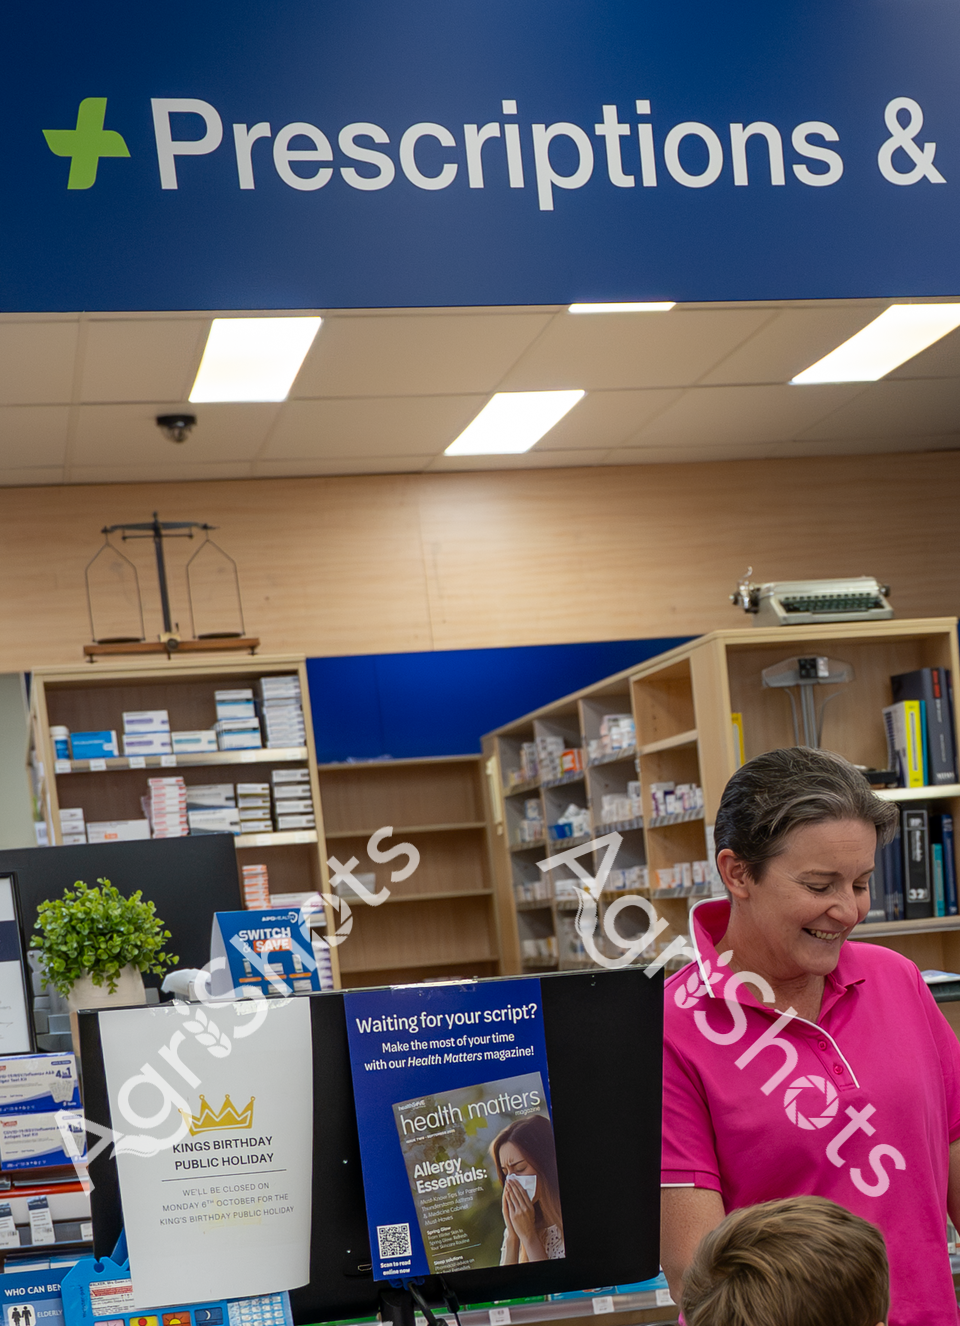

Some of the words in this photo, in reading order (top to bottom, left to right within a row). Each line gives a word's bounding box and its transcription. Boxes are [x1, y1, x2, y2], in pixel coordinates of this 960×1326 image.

[151, 98, 843, 211] Prescriptions
[877, 97, 946, 186] &
[239, 927, 291, 941] SWITCH
[256, 939, 290, 951] SAVE
[356, 1015, 418, 1033] Waiting
[420, 1012, 442, 1028] for
[445, 1012, 481, 1030] your
[484, 1003, 538, 1024] script?
[382, 1042, 409, 1054] Make
[411, 1039, 428, 1050] the
[429, 1038, 455, 1049] most
[457, 1035, 468, 1046] of
[468, 1036, 491, 1047] your
[492, 1032, 515, 1043] time
[364, 1060, 387, 1071] with
[389, 1059, 406, 1069] our
[408, 1054, 442, 1067] Health
[444, 1052, 483, 1064] Matters
[484, 1046, 534, 1061] magazine!
[400, 1103, 463, 1135] health
[468, 1090, 541, 1119] matters
[173, 1141, 210, 1153] KINGS
[213, 1136, 273, 1150] BIRTHDAY
[175, 1158, 219, 1170] PUBLIC
[222, 1153, 274, 1166] HOLIDAY
[414, 1157, 462, 1179] Allergy
[183, 1187, 208, 1196] WE'LL
[223, 1183, 256, 1193] CLOSED
[416, 1167, 488, 1194] Essentials:
[162, 1202, 199, 1212] MONDAY
[216, 1197, 255, 1207] OCTOBER
[160, 1217, 187, 1225] KING'S
[190, 1213, 231, 1222] BIRTHDAY
[233, 1210, 261, 1218] PUBLIC
[264, 1206, 294, 1215] HOLIDAY
[4, 1287, 25, 1297] WHO
[28, 1286, 45, 1294] CAN
[37, 1309, 62, 1318] ELDERLY
